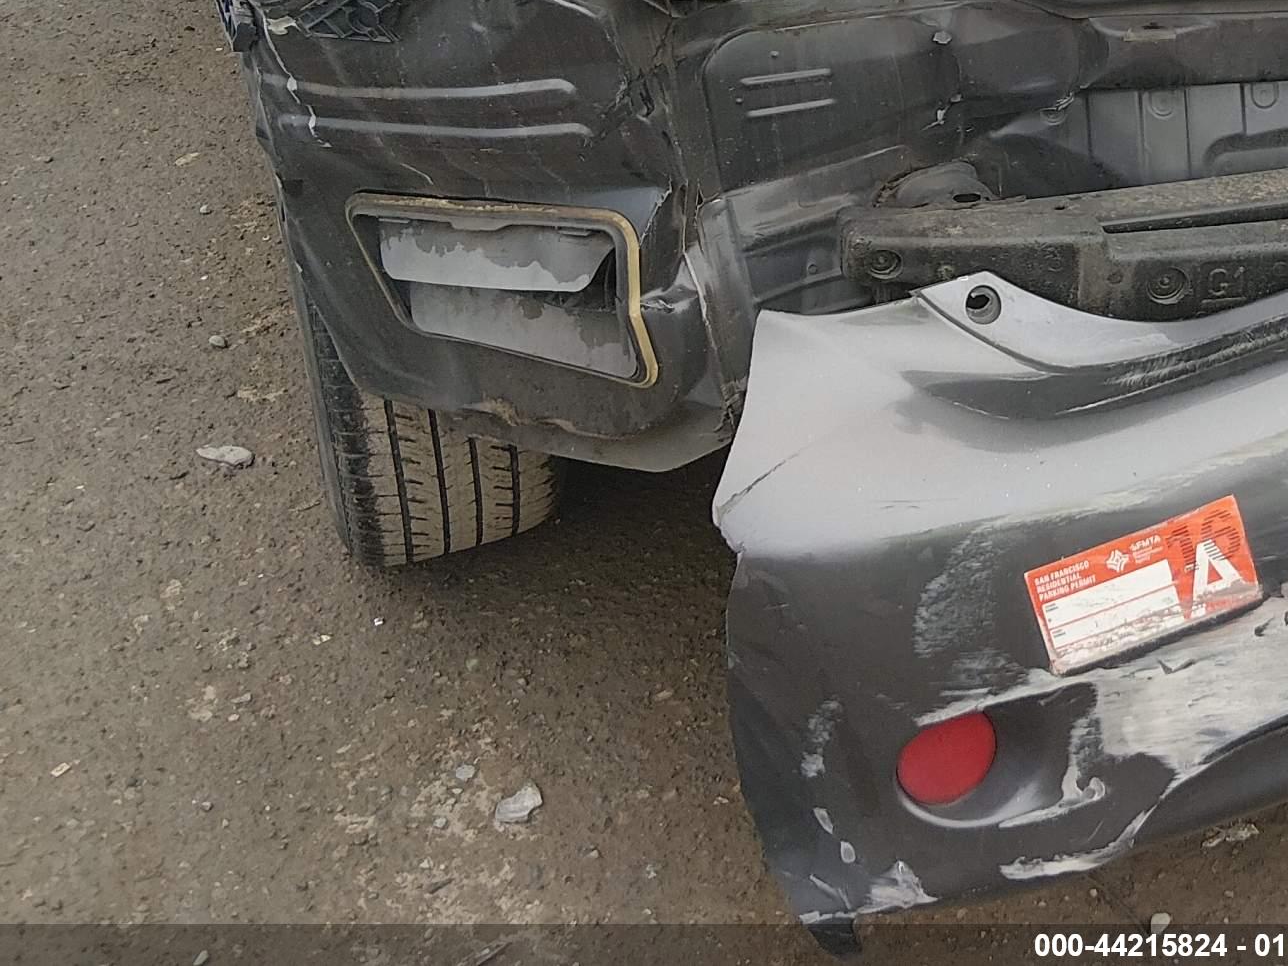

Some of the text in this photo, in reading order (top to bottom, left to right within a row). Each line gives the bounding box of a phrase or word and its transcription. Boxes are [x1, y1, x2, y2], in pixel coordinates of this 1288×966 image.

[1034, 560, 1090, 587] SAN FRANCISCO
[1036, 574, 1081, 594] RESIDENTIAL
[1190, 538, 1246, 620] A
[1039, 574, 1096, 602] PARKING PERMIT
